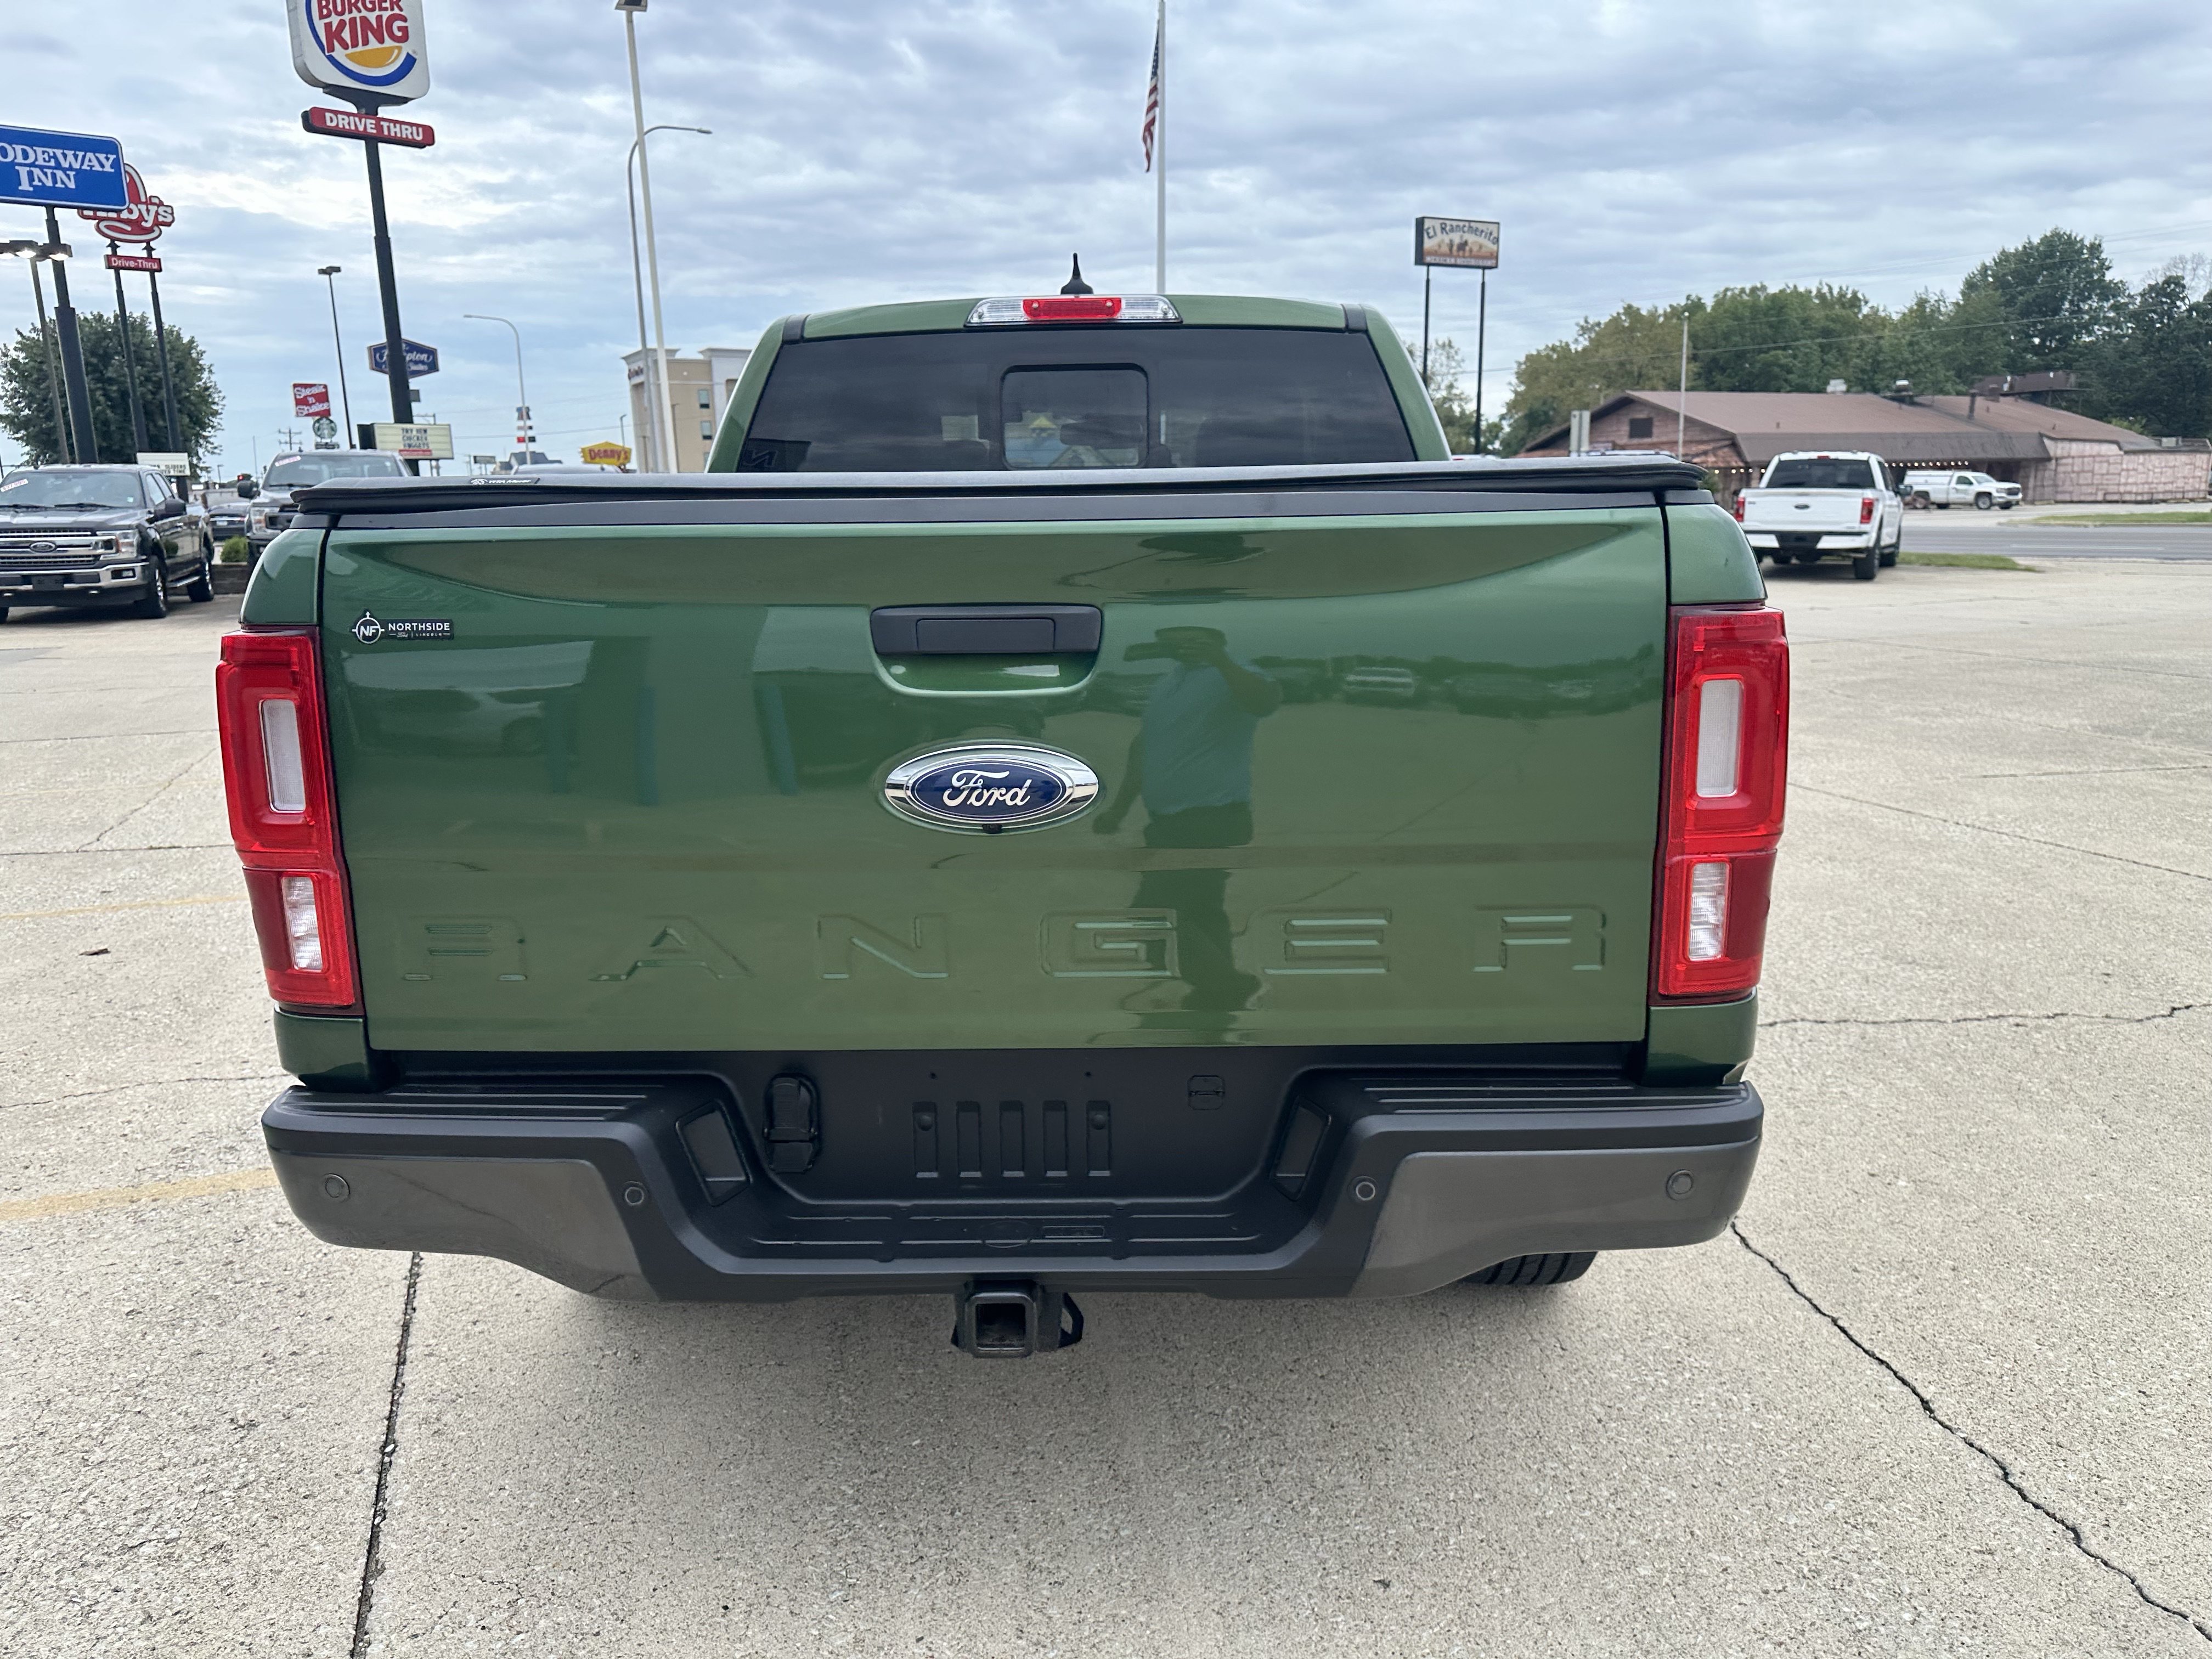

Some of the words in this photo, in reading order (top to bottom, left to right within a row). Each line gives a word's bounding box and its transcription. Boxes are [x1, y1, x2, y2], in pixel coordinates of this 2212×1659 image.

[324, 13, 409, 53] KING
[325, 112, 377, 133] DRIVE
[380, 121, 423, 140] THRU
[15, 166, 76, 191] INN
[1424, 225, 1437, 239] El
[1440, 222, 1498, 245] Rancherito
[111, 258, 158, 269] Drive-Thru
[588, 447, 629, 461] Denny's
[388, 623, 450, 631] NORTHSIDE
[943, 770, 1032, 807] Ford
[399, 903, 1607, 980] RANGER
